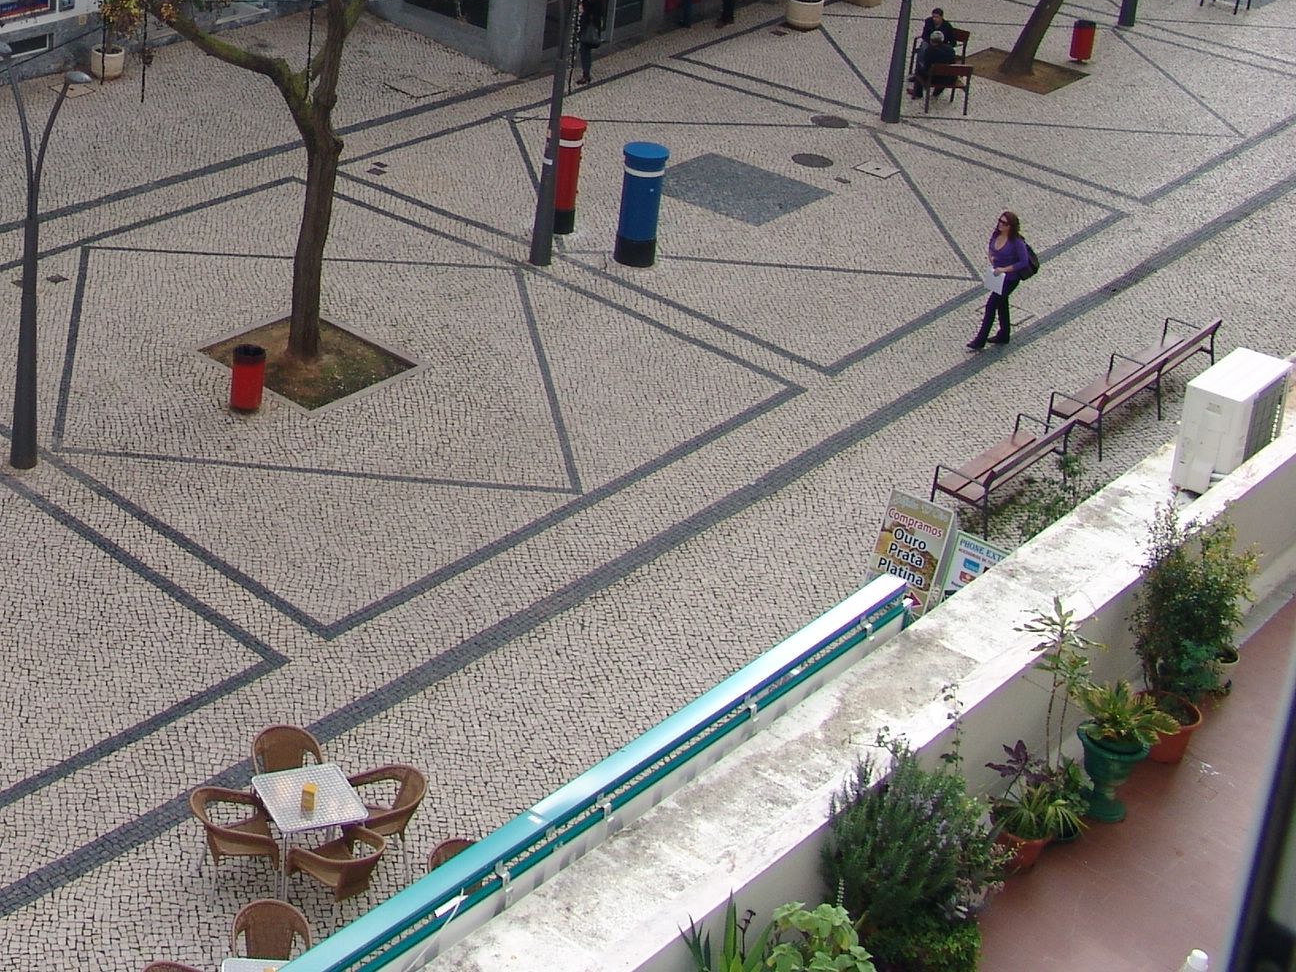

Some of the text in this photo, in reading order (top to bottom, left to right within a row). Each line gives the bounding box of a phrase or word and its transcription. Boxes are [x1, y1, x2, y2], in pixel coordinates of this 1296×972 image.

[887, 508, 944, 539] Compramos
[893, 528, 928, 551] Ouro
[959, 538, 985, 555] PHONE
[888, 542, 925, 569] Prata
[878, 557, 925, 588] Platina
